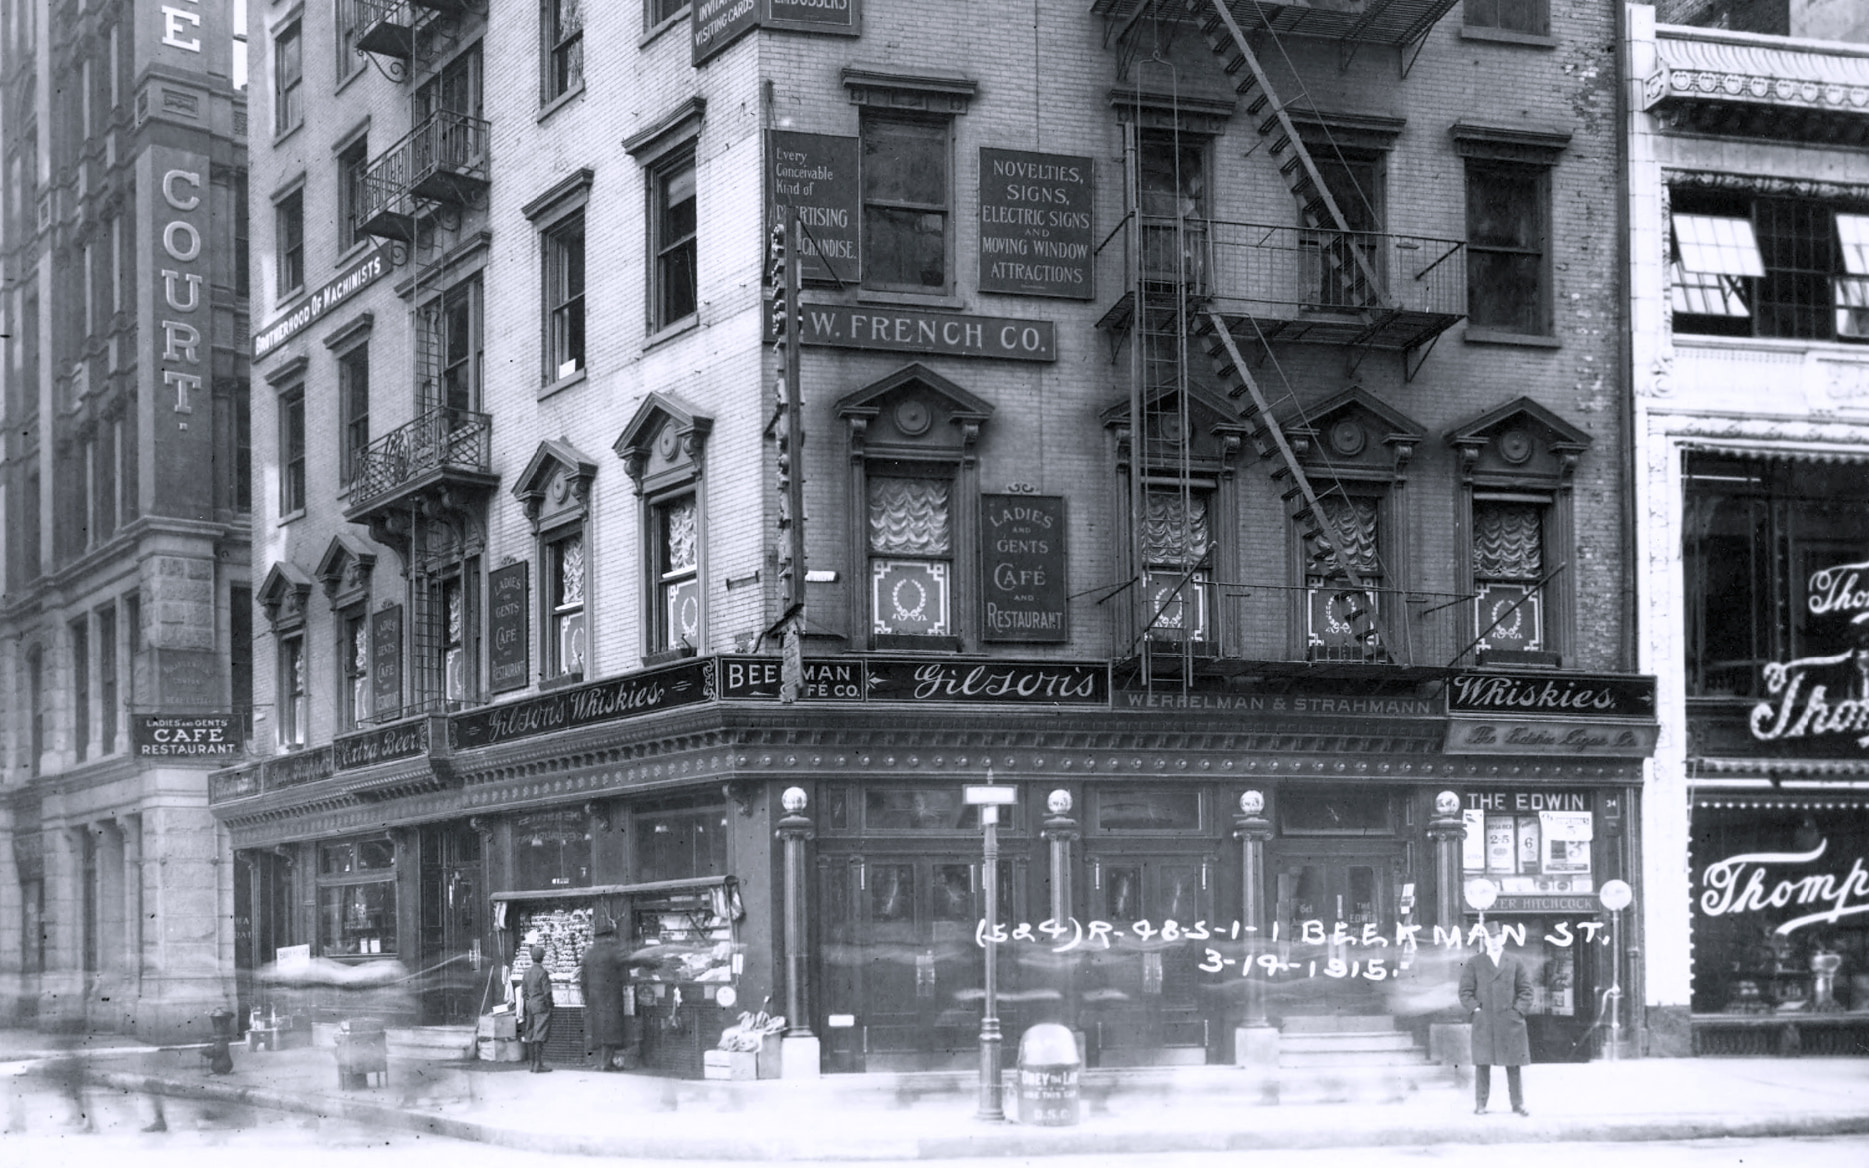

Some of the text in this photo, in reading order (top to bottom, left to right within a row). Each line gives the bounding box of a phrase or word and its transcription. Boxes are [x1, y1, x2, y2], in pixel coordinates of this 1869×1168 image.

[694, 12, 728, 47] VISITING
[775, 147, 808, 166] Every
[775, 162, 834, 181] Conceivable
[993, 159, 1085, 185] NOVELTIES,
[775, 178, 815, 196] Kind of
[1007, 184, 1070, 206] SIGNS,
[982, 204, 1090, 229] ELECTRIC SIGNS
[1025, 228, 1050, 238] AND
[982, 236, 1089, 260] MOVING WINDOW
[323, 256, 382, 309] MACHINISTS
[990, 261, 1083, 284] ATTRACTIONS
[850, 313, 984, 350] FRENCH
[1000, 325, 1047, 353] CO.
[989, 507, 1055, 530] LADIES
[1012, 525, 1032, 534] AND
[1013, 594, 1035, 602] AND
[1808, 561, 1869, 615] Tho
[986, 602, 1063, 633] RESTAURANT
[729, 663, 851, 689] BEEMAN
[913, 662, 1095, 700] Gilson's
[833, 684, 861, 698] CO.
[1272, 697, 1288, 711] &
[141, 743, 236, 756] RESTAURANT
[1466, 792, 1507, 811] THE
[1515, 792, 1585, 811] EDWIN
[1522, 897, 1593, 910] HITCHCOCK
